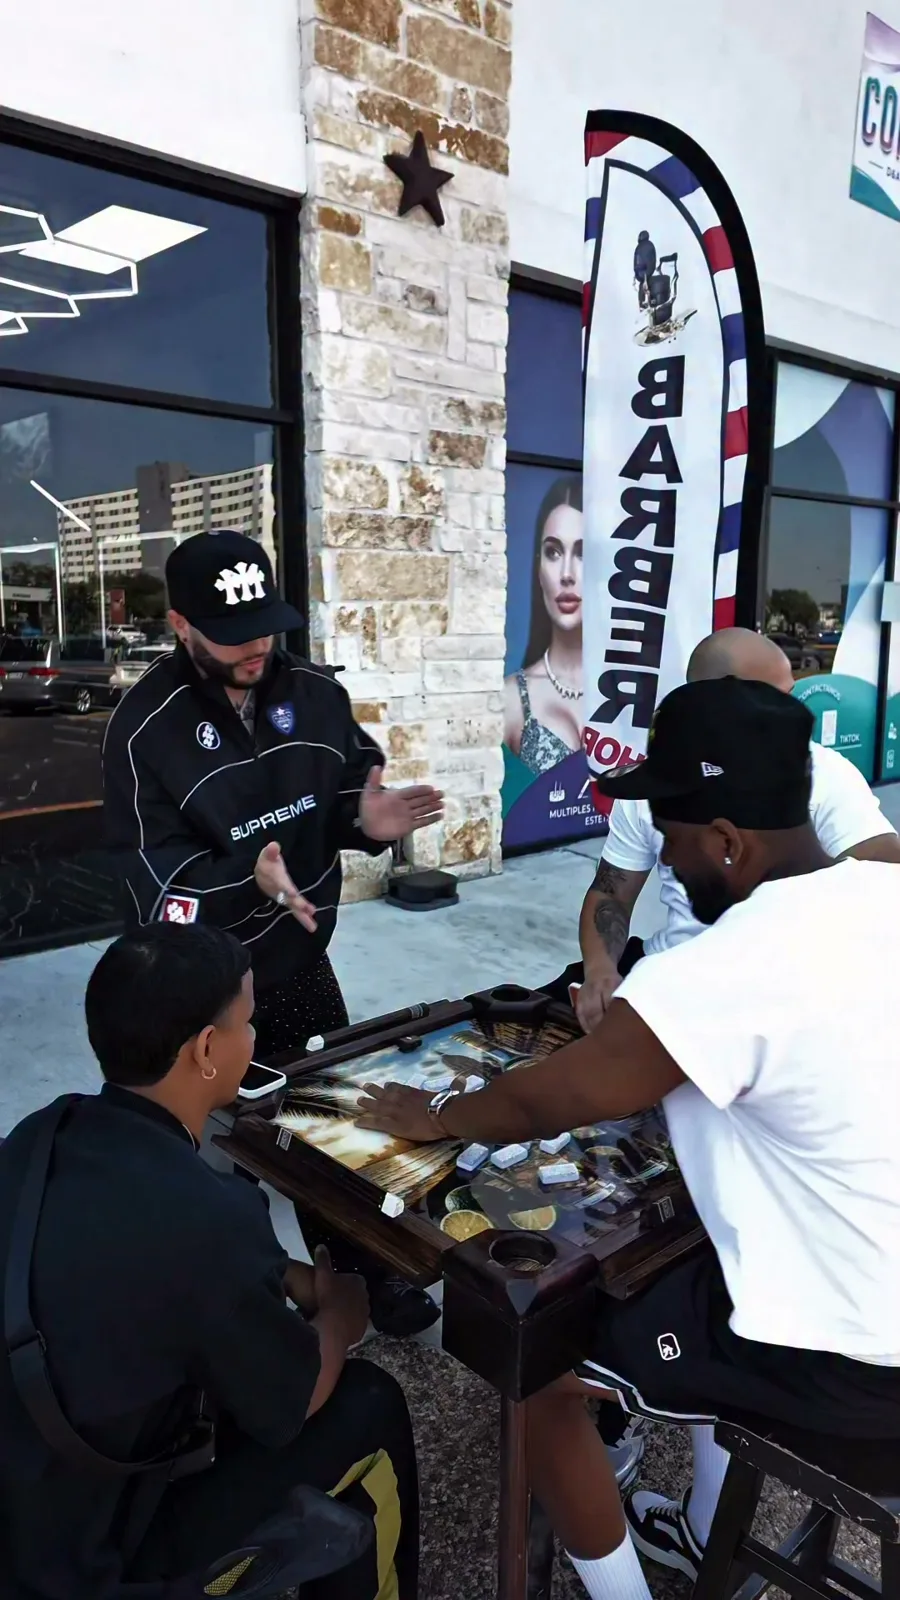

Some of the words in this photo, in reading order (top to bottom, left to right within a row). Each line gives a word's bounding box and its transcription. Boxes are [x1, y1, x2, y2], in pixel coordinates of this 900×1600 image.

[861, 76, 900, 160] CO
[840, 733, 860, 744] TIKTOK
[230, 794, 317, 841] SUPREME
[549, 803, 591, 819] MULTIPLES
